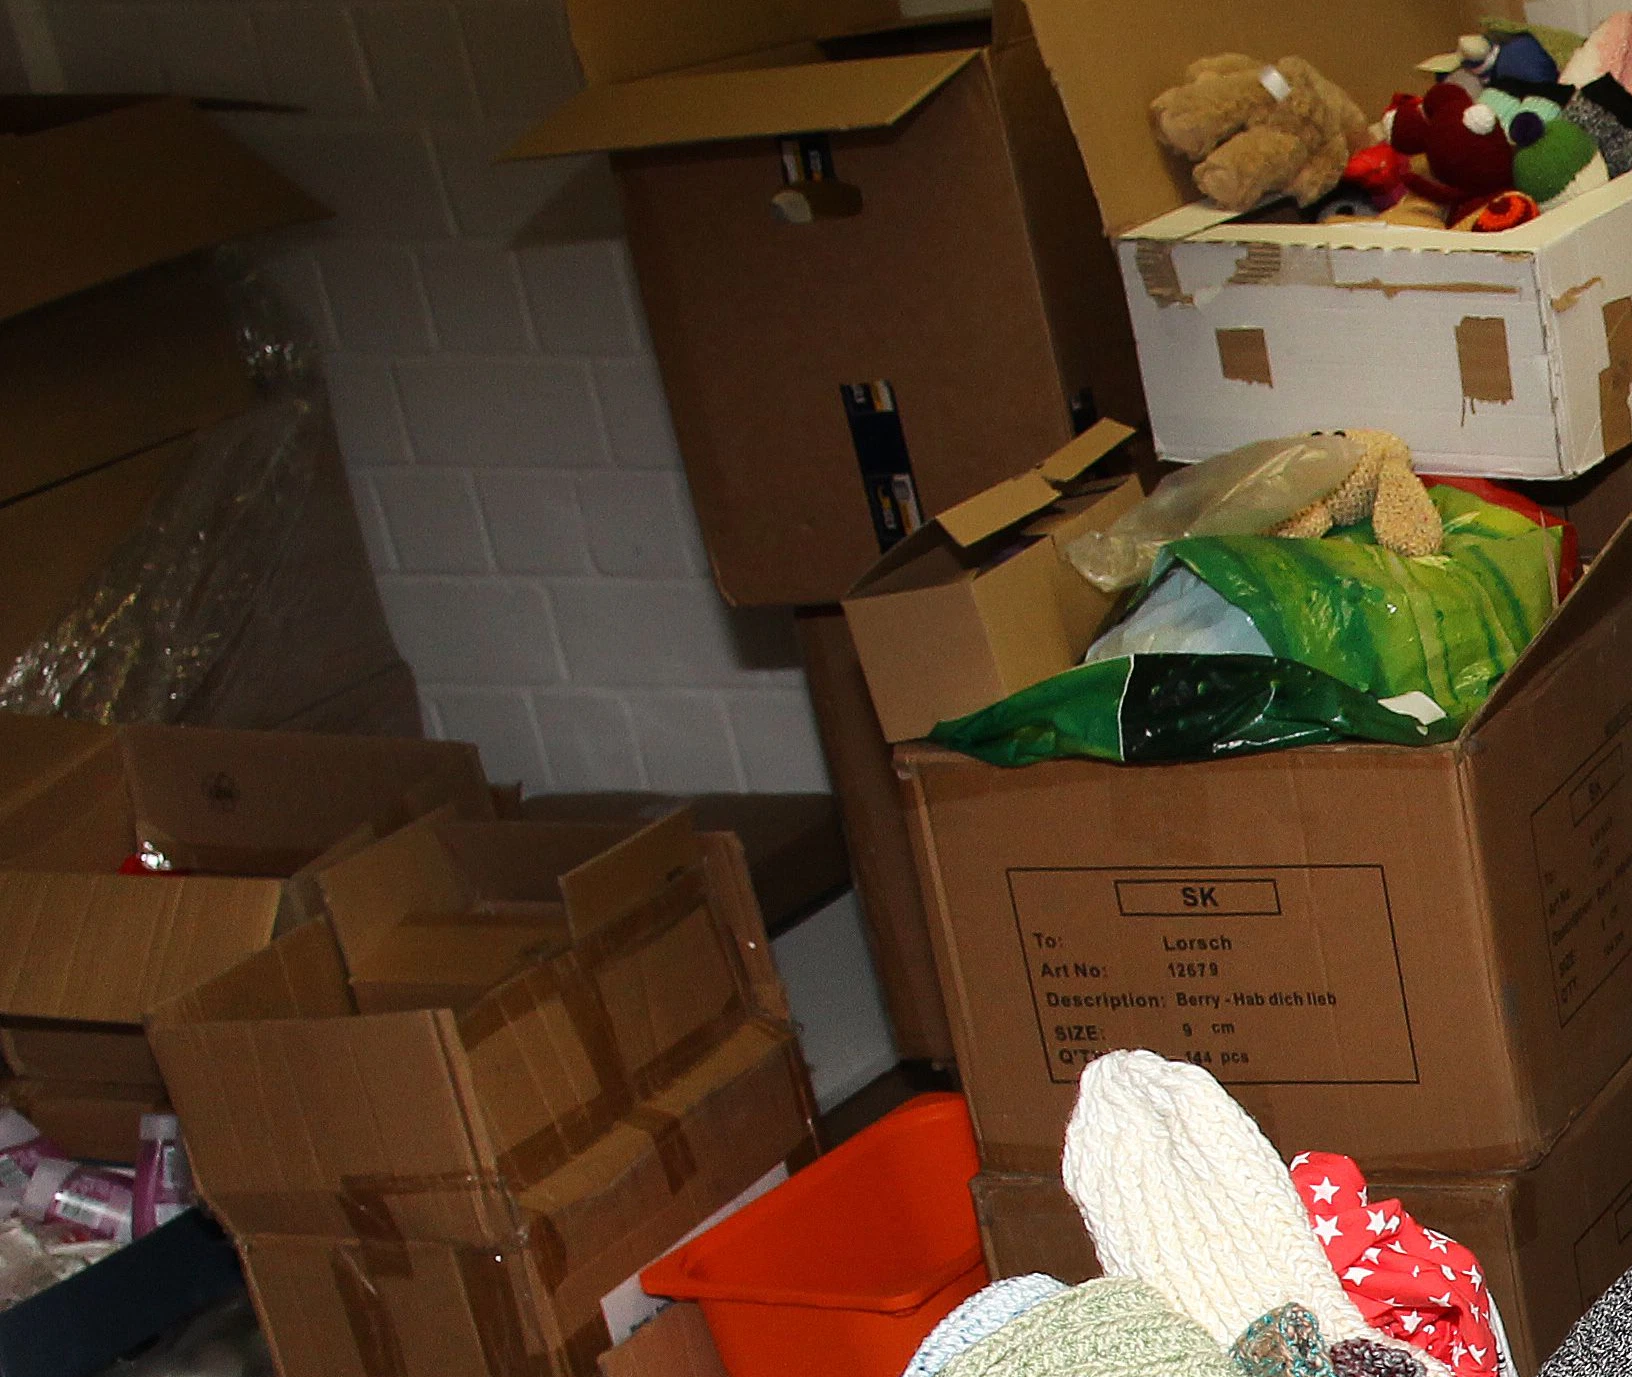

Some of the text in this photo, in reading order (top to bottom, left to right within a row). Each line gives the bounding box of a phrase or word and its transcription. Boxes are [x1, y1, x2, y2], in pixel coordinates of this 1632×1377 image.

[1181, 886, 1219, 909] SK
[1032, 931, 1233, 952] To: Lorsch
[1040, 963, 1071, 980] Art
[1167, 961, 1219, 979] 12679
[1046, 990, 1167, 1010] Description:
[1176, 991, 1220, 1010] Berry
[1233, 992, 1266, 1007] Hab
[1268, 991, 1304, 1007] dich
[1054, 1020, 1235, 1042] SIZE: 9 cm
[1220, 1050, 1250, 1066] pcs
